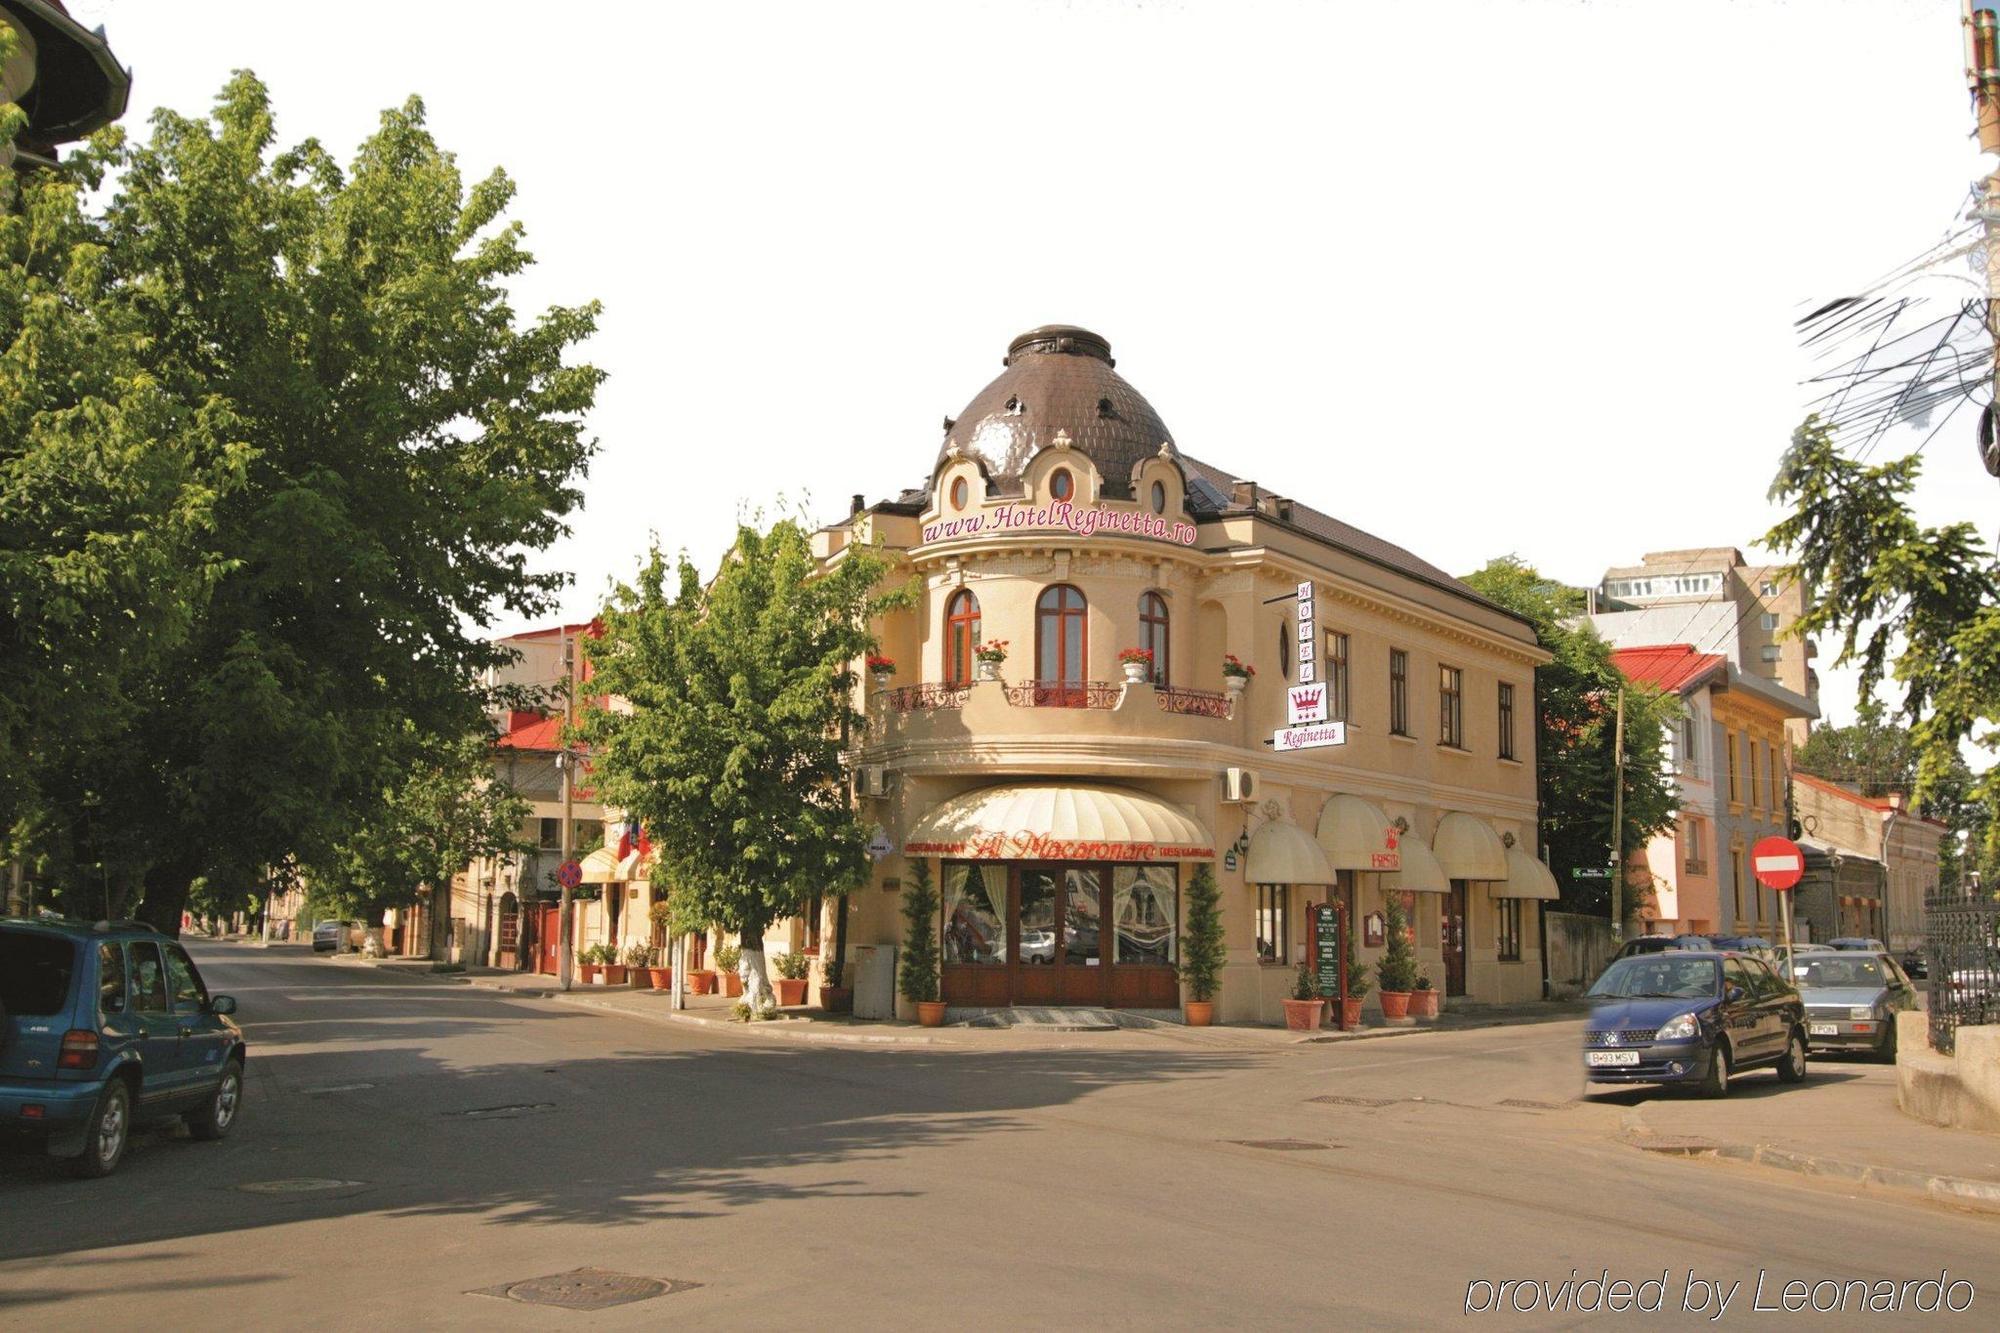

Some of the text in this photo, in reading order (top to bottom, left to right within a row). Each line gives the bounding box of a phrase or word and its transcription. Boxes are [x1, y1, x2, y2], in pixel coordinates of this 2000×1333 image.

[924, 501, 1197, 544] www.HotelReginetta.ro
[1299, 583, 1312, 679] HOTEL
[1283, 728, 1337, 748] Reginetta
